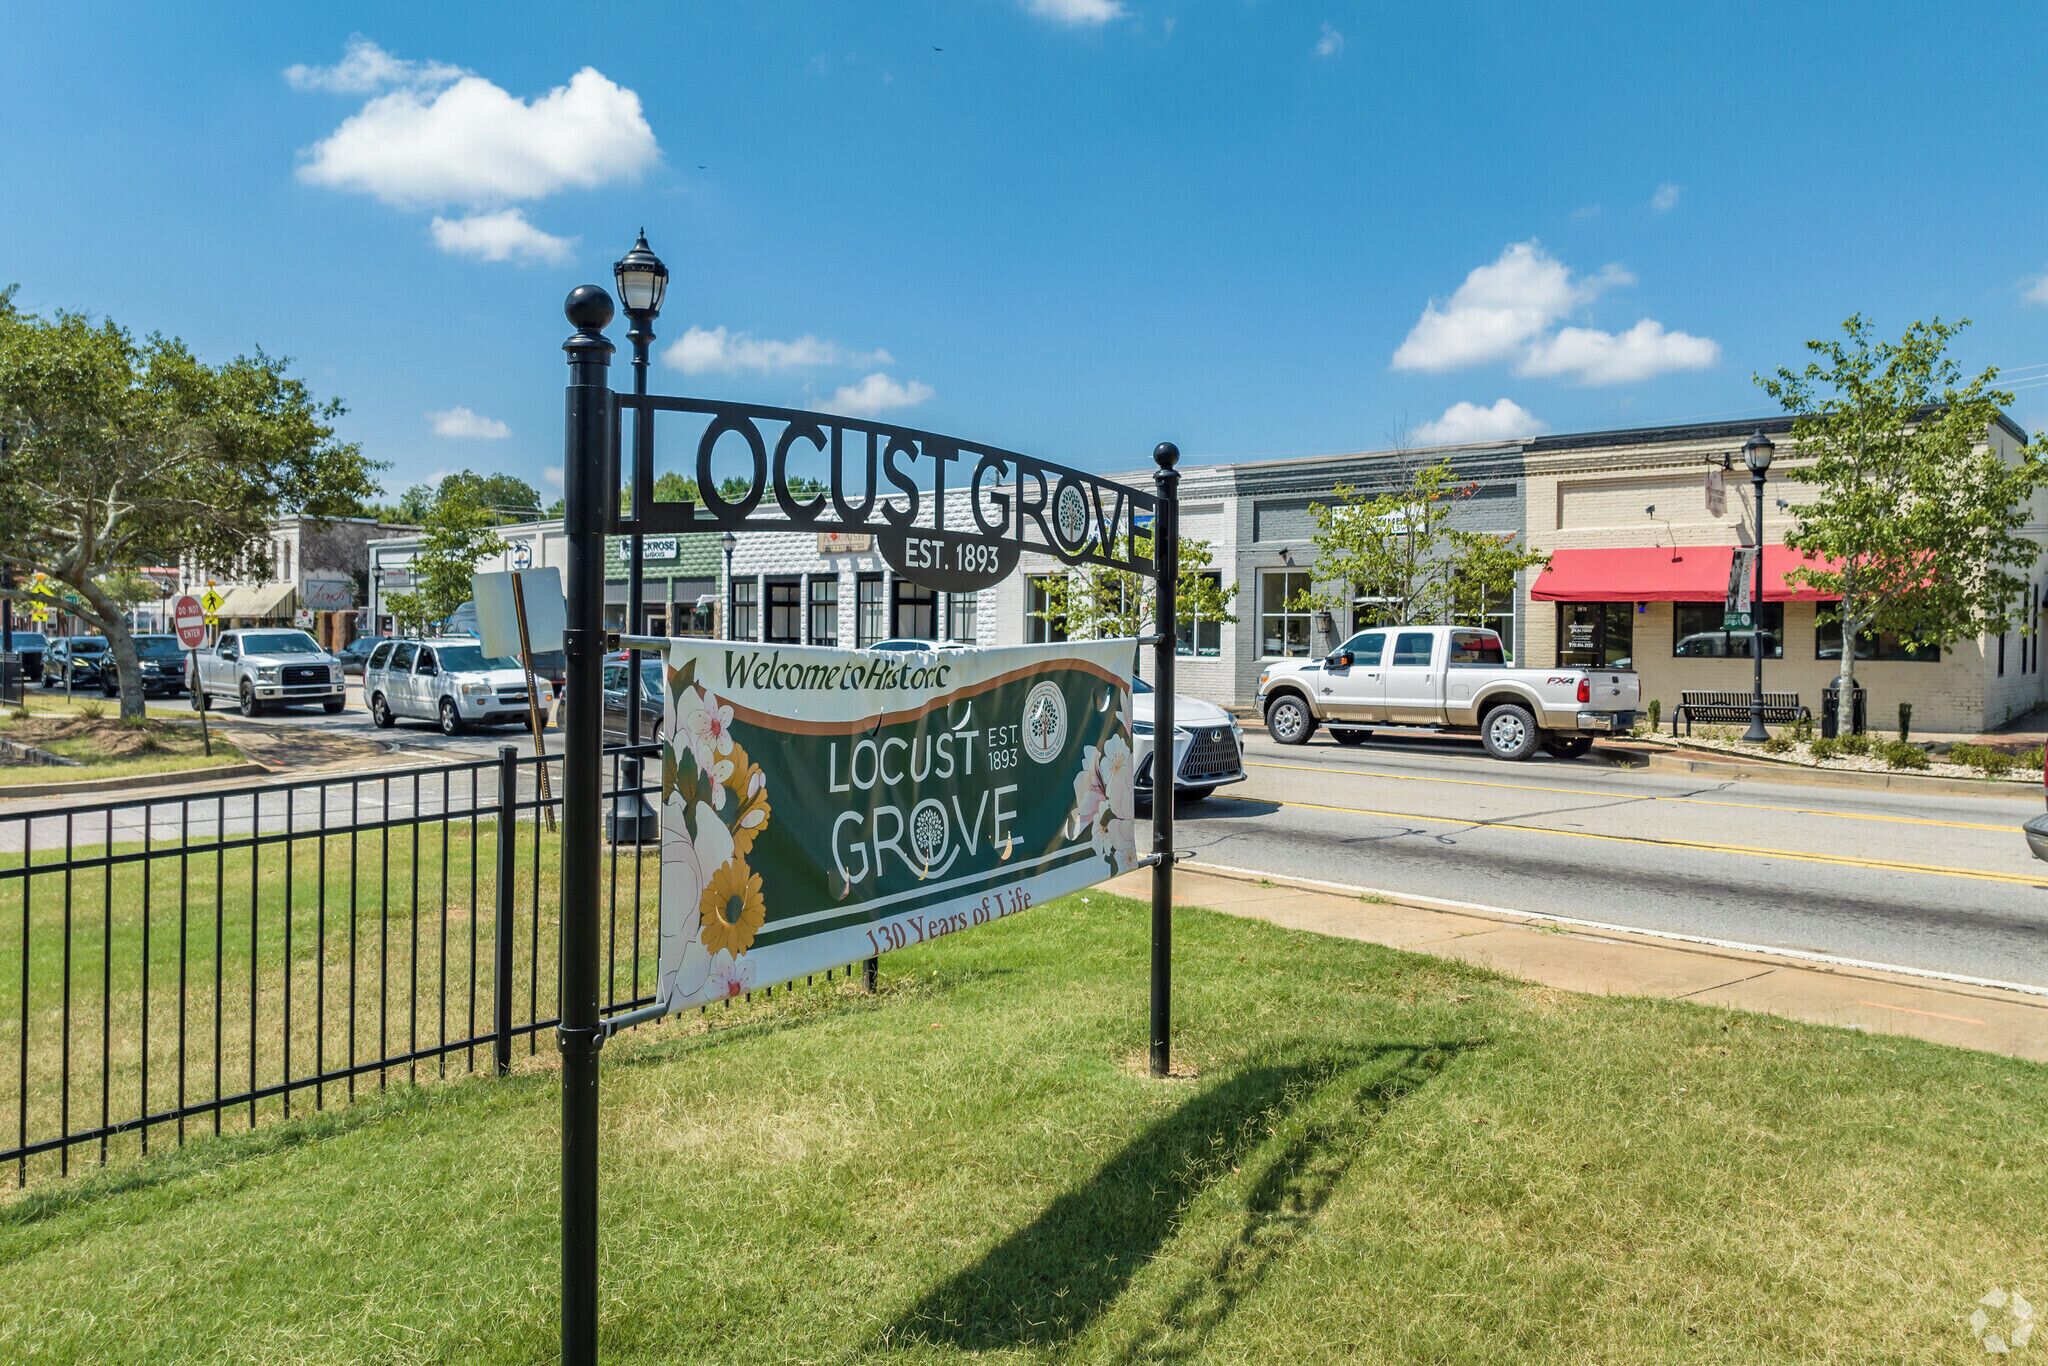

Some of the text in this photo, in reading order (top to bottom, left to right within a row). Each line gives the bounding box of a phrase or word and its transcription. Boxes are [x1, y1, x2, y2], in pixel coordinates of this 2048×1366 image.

[638, 398, 1155, 568] LOCUST GROVE
[905, 537, 999, 574] EST. 1893
[1740, 564, 1751, 610] WELCOME
[178, 604, 200, 616] DO NOT
[183, 628, 201, 639] ENTER
[724, 650, 951, 691] Welcome to Historic
[1547, 677, 1575, 685] FX4
[988, 725, 1018, 747] EST.
[829, 731, 980, 793] LOCUST
[988, 748, 1018, 771] 1893
[832, 784, 1025, 884] GROVE
[866, 886, 1033, 957] 130 Years of Life
